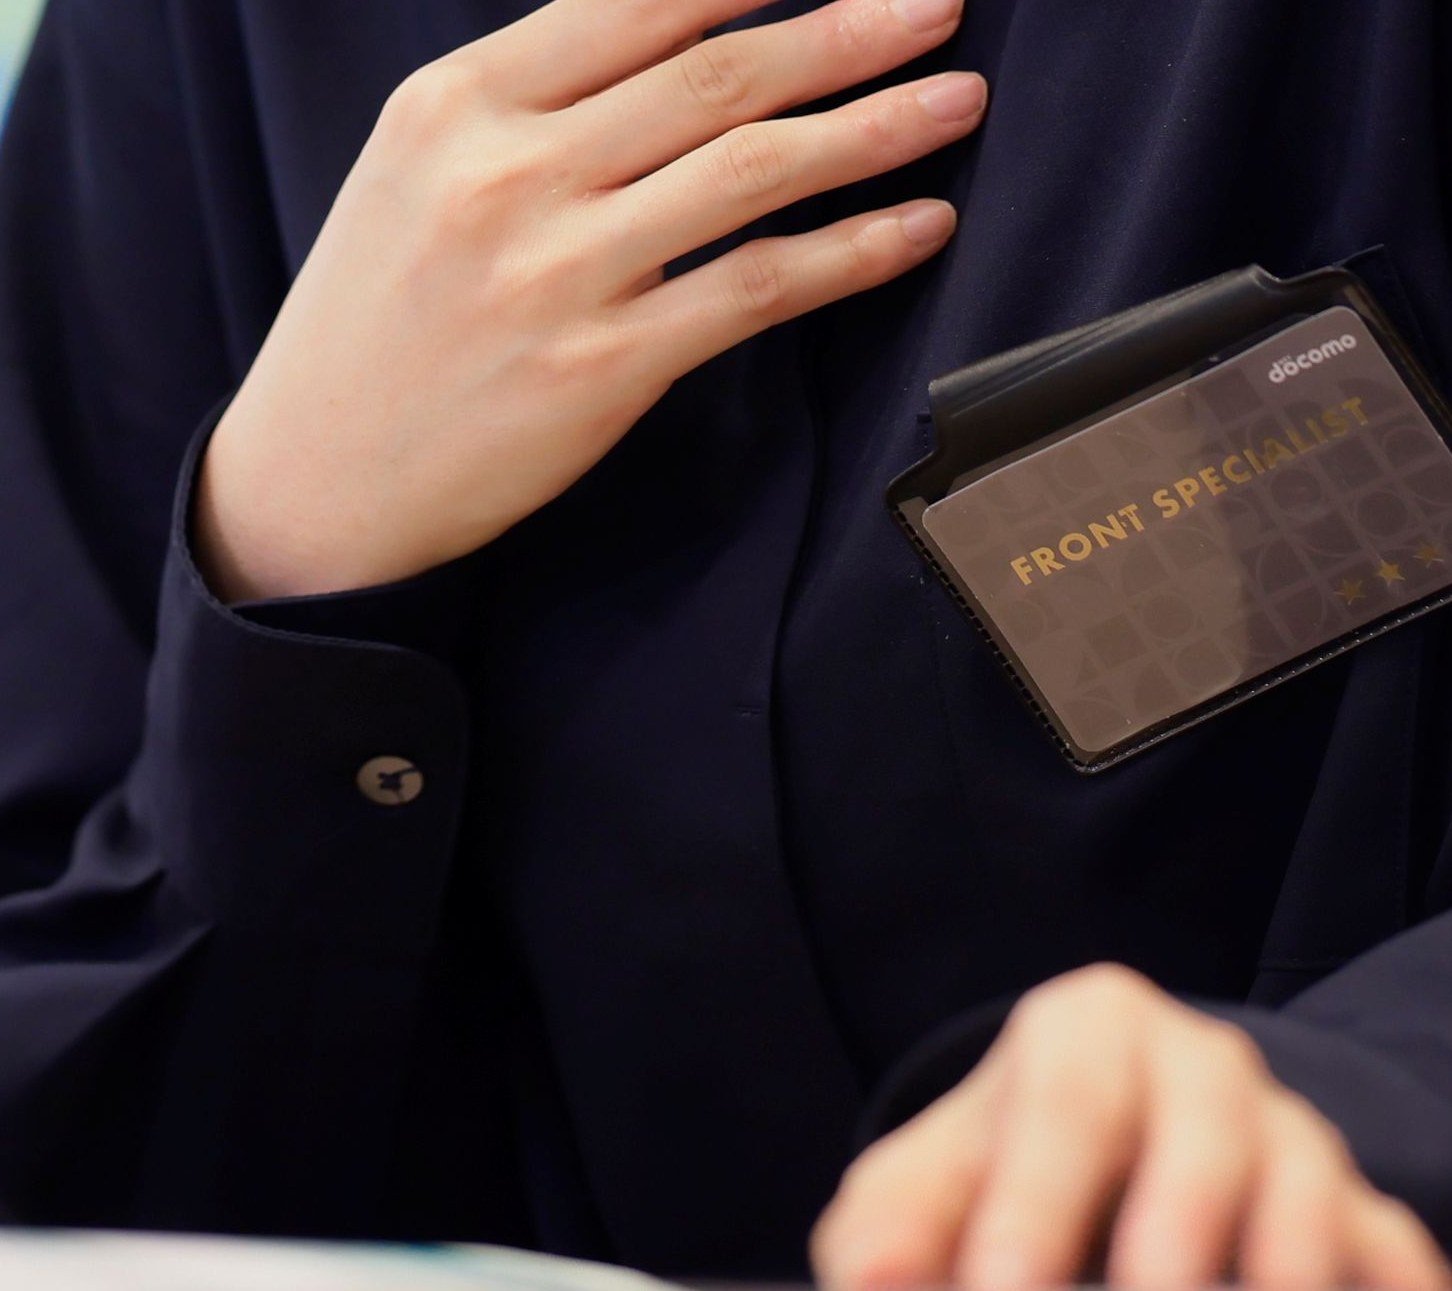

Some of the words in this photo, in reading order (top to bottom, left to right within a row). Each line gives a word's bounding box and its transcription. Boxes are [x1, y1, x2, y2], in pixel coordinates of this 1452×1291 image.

[1268, 334, 1357, 383] docomo
[1010, 503, 1145, 586] FRONT
[1152, 397, 1369, 519] SPECIALIST
